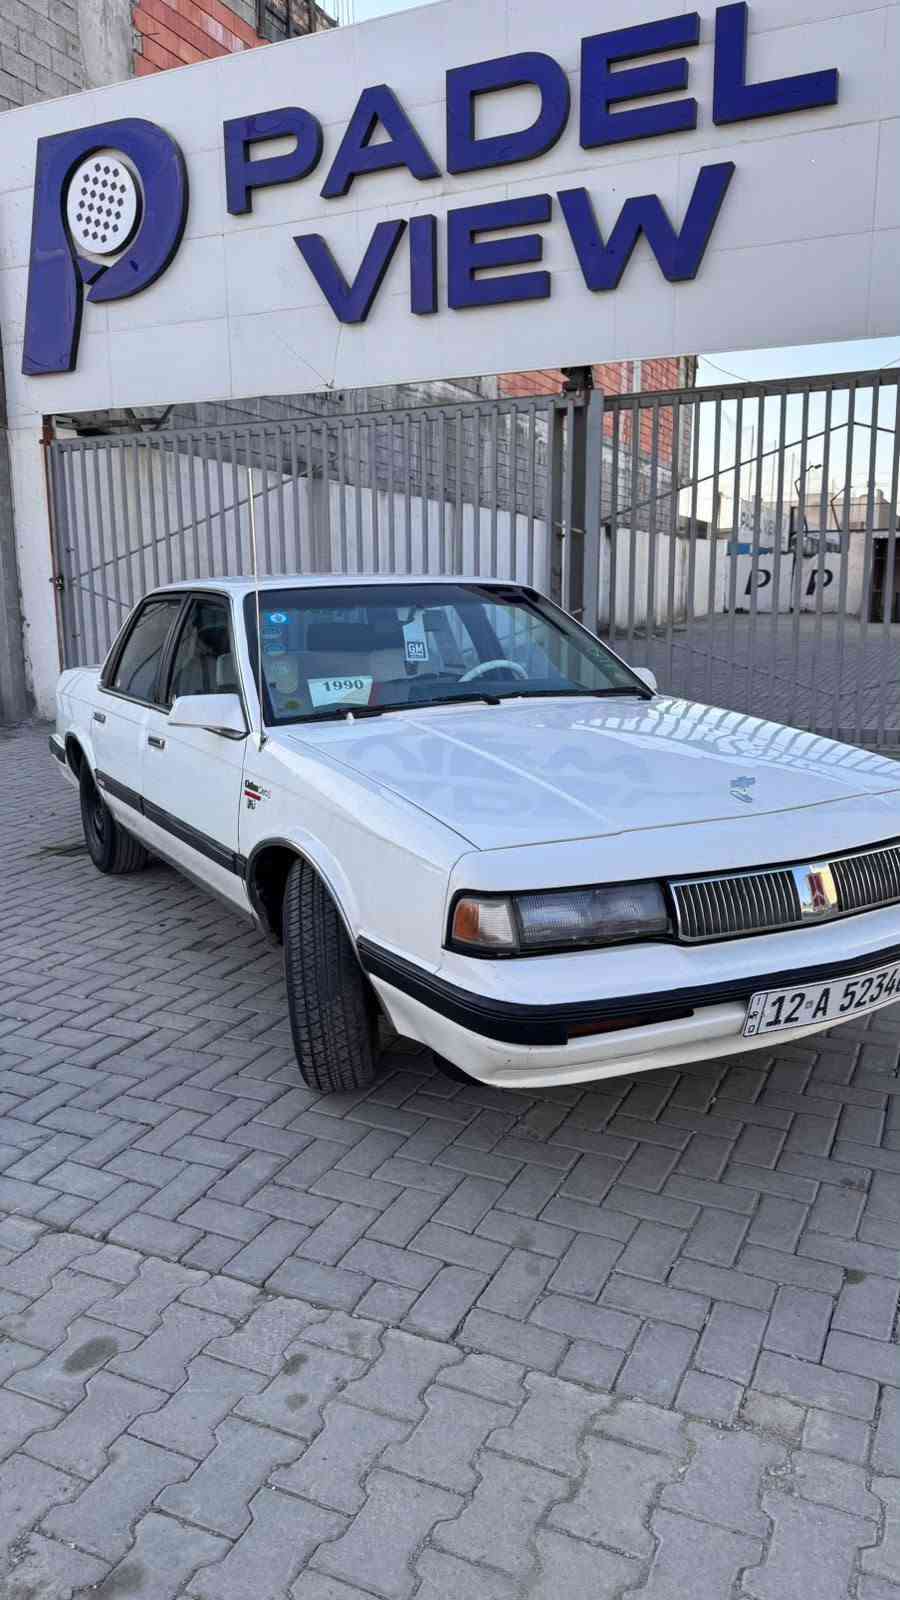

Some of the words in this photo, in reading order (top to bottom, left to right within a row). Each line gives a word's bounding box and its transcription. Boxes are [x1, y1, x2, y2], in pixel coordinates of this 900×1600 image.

[223, 1, 839, 215] PADEL
[293, 161, 736, 324] VIEW
[322, 679, 364, 692] 1990
[766, 992, 806, 1027] 12
[812, 987, 831, 1018] A
[839, 968, 900, 1012] 5234
